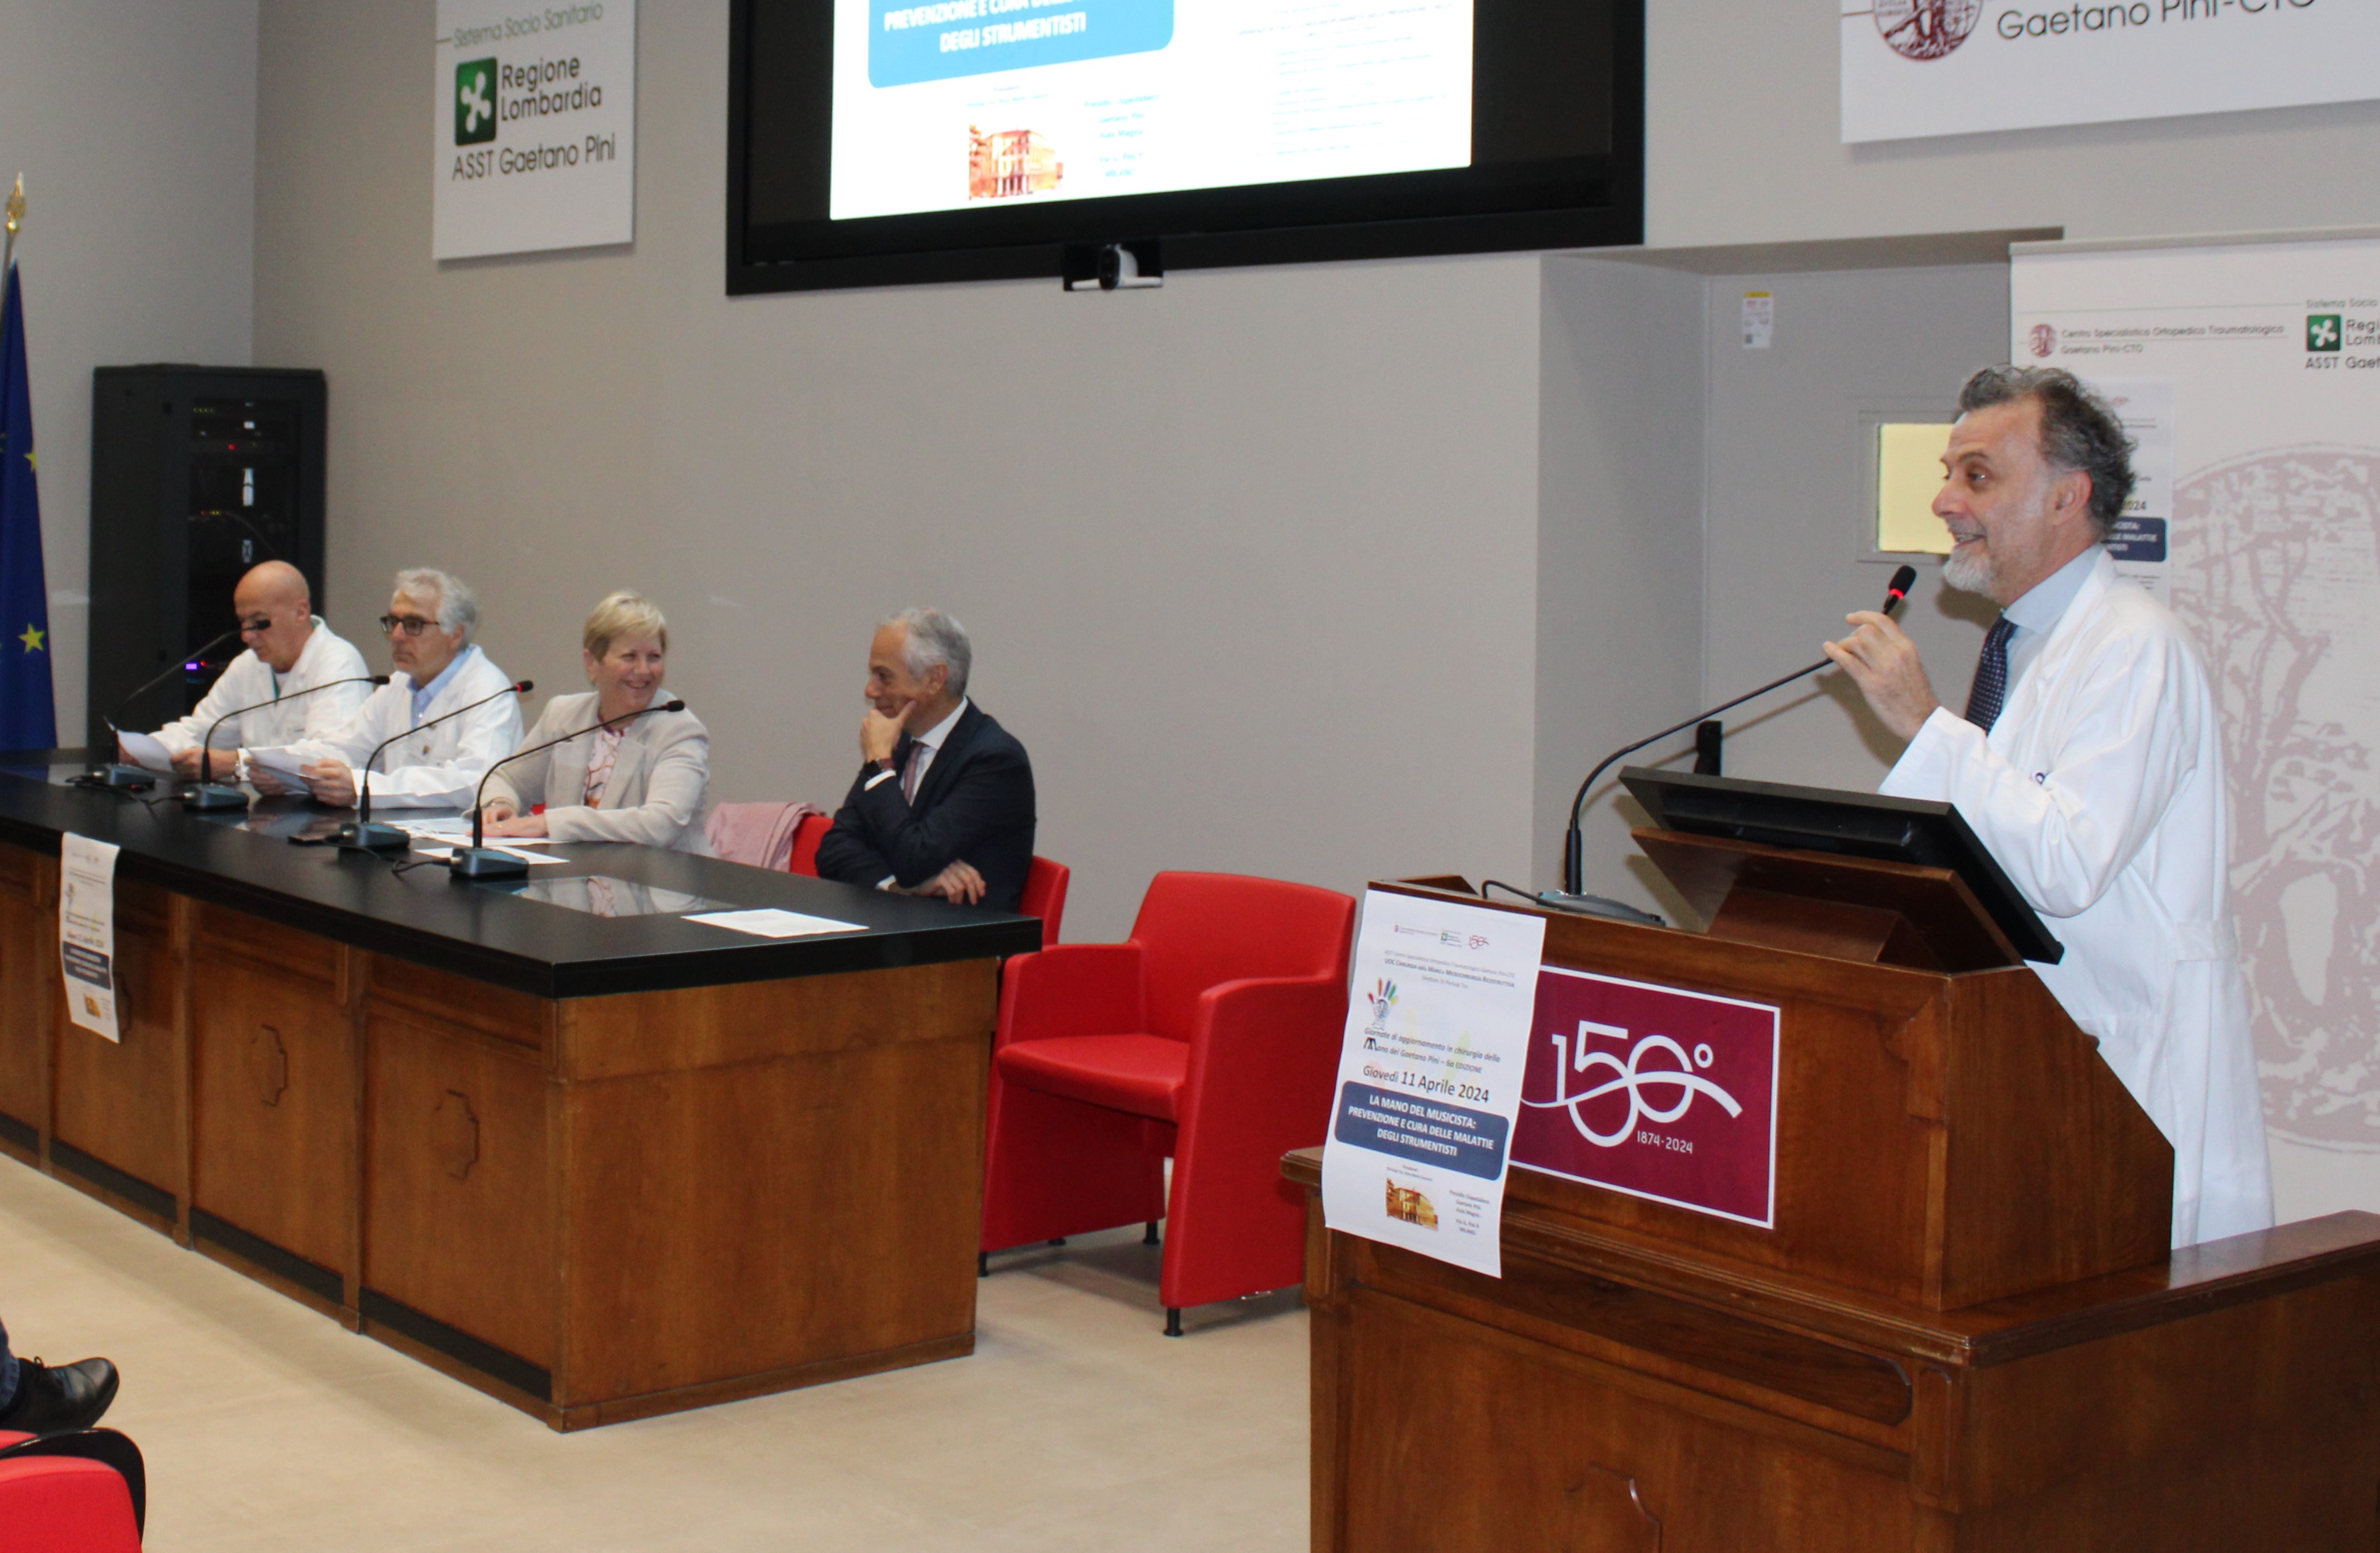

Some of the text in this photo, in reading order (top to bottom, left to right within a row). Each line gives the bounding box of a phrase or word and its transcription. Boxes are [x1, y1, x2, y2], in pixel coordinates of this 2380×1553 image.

[454, 2, 604, 48] Sistema Socio Sanitario
[884, 2, 978, 31] PREVENZIONE
[979, 0, 988, 16] E
[940, 12, 1087, 53] DEGLI STRUMENTISTI
[1998, 0, 2150, 40] Gaetano
[502, 57, 580, 91] Regione
[501, 82, 602, 122] Lombardia
[452, 132, 617, 181] ASST Gaetano Pini
[2305, 356, 2340, 369] ASST
[1364, 1027, 1391, 1040] Giornate
[1398, 1036, 1446, 1051] aggiornamento
[1446, 1043, 1454, 1053] in
[1454, 1045, 1483, 1059] chirurgia
[1483, 1053, 1501, 1063] della
[1390, 1047, 1399, 1056] del
[1400, 1050, 1427, 1062] Gaetano
[1427, 1054, 1440, 1064] Pini
[1455, 1061, 1483, 1074] EDIZIONE
[1401, 1071, 1415, 1087] 11
[1417, 1075, 1456, 1096] Aprile
[1458, 1084, 1490, 1103] 2024
[1348, 1105, 1495, 1150] PREVENZIONE E CURA DELLE MALATTIE
[1369, 1094, 1477, 1130] LA MANO DEL MUSICISTA:
[1377, 1127, 1458, 1157] DEGLI STRUMENTISTI
